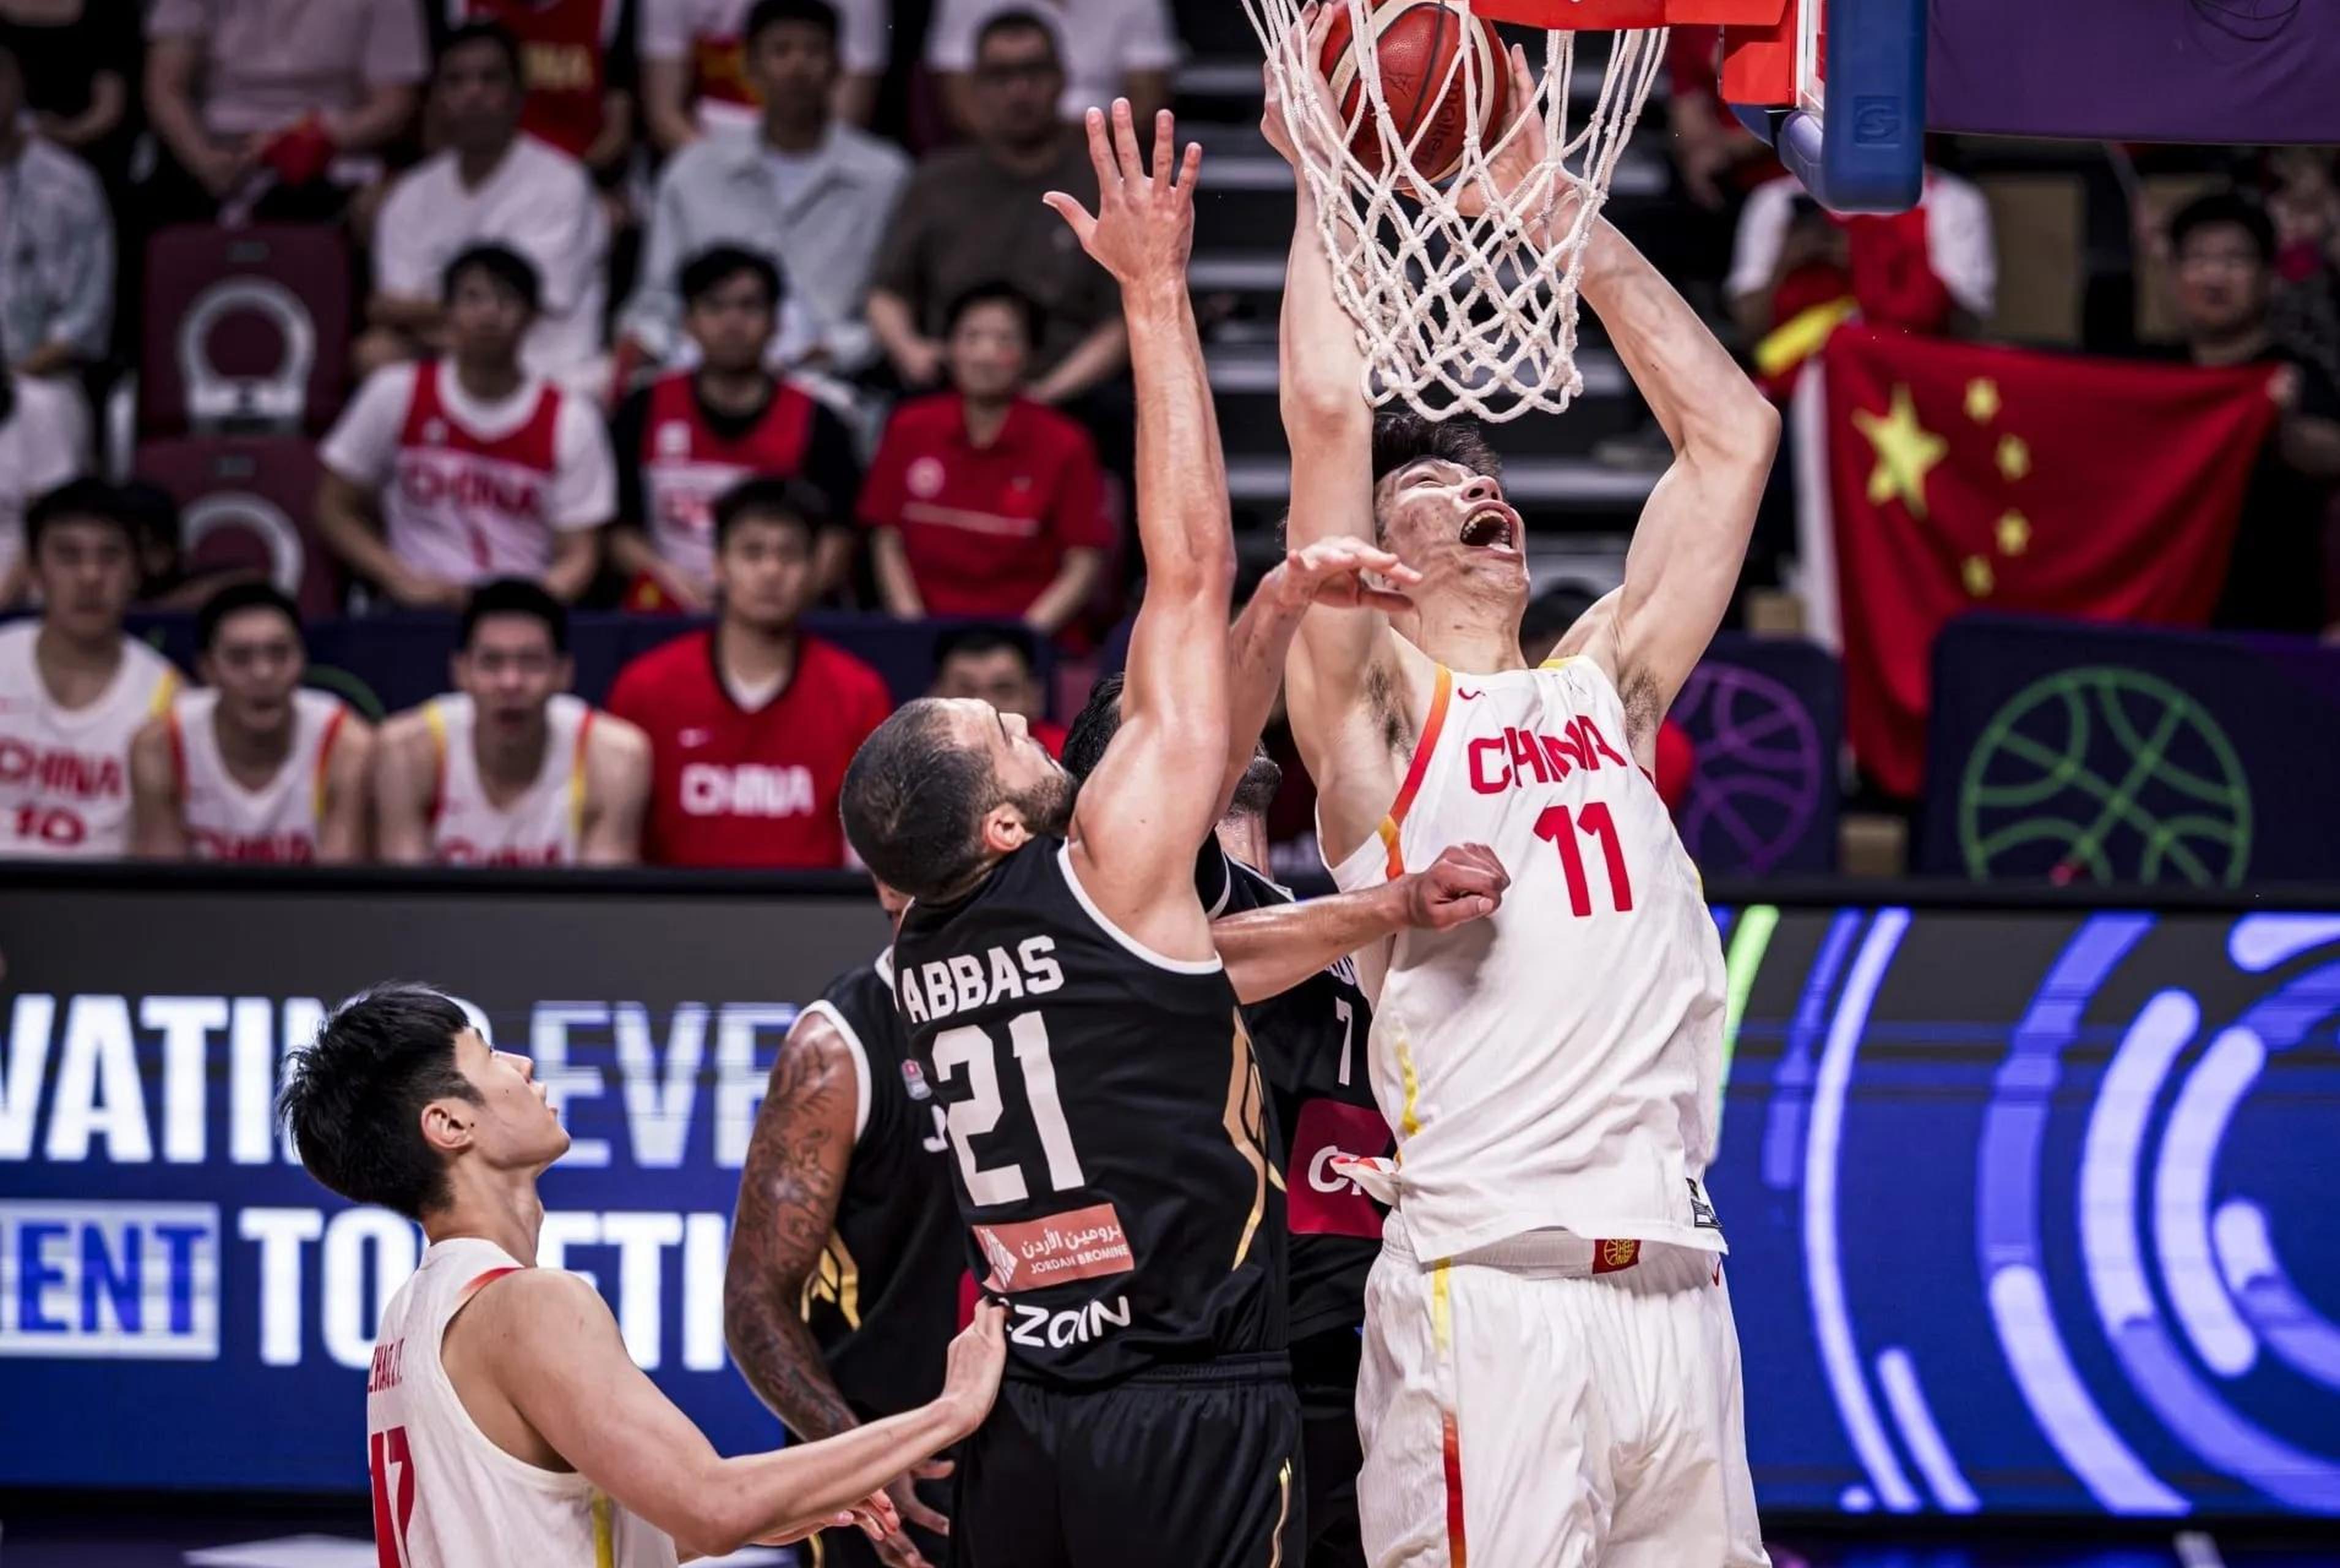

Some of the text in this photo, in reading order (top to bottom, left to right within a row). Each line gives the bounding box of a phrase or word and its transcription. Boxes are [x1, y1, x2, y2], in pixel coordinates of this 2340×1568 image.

[679, 763, 815, 818] CHINA
[1468, 715, 1628, 794] CHINA
[15, 802, 88, 849] 10
[1533, 802, 1633, 917] 11
[902, 935, 1065, 1023] ABBAS
[1335, 997, 1353, 1086] 7
[932, 1011, 1085, 1207] 21
[1030, 1244, 1130, 1275] JORDAN BROMINE
